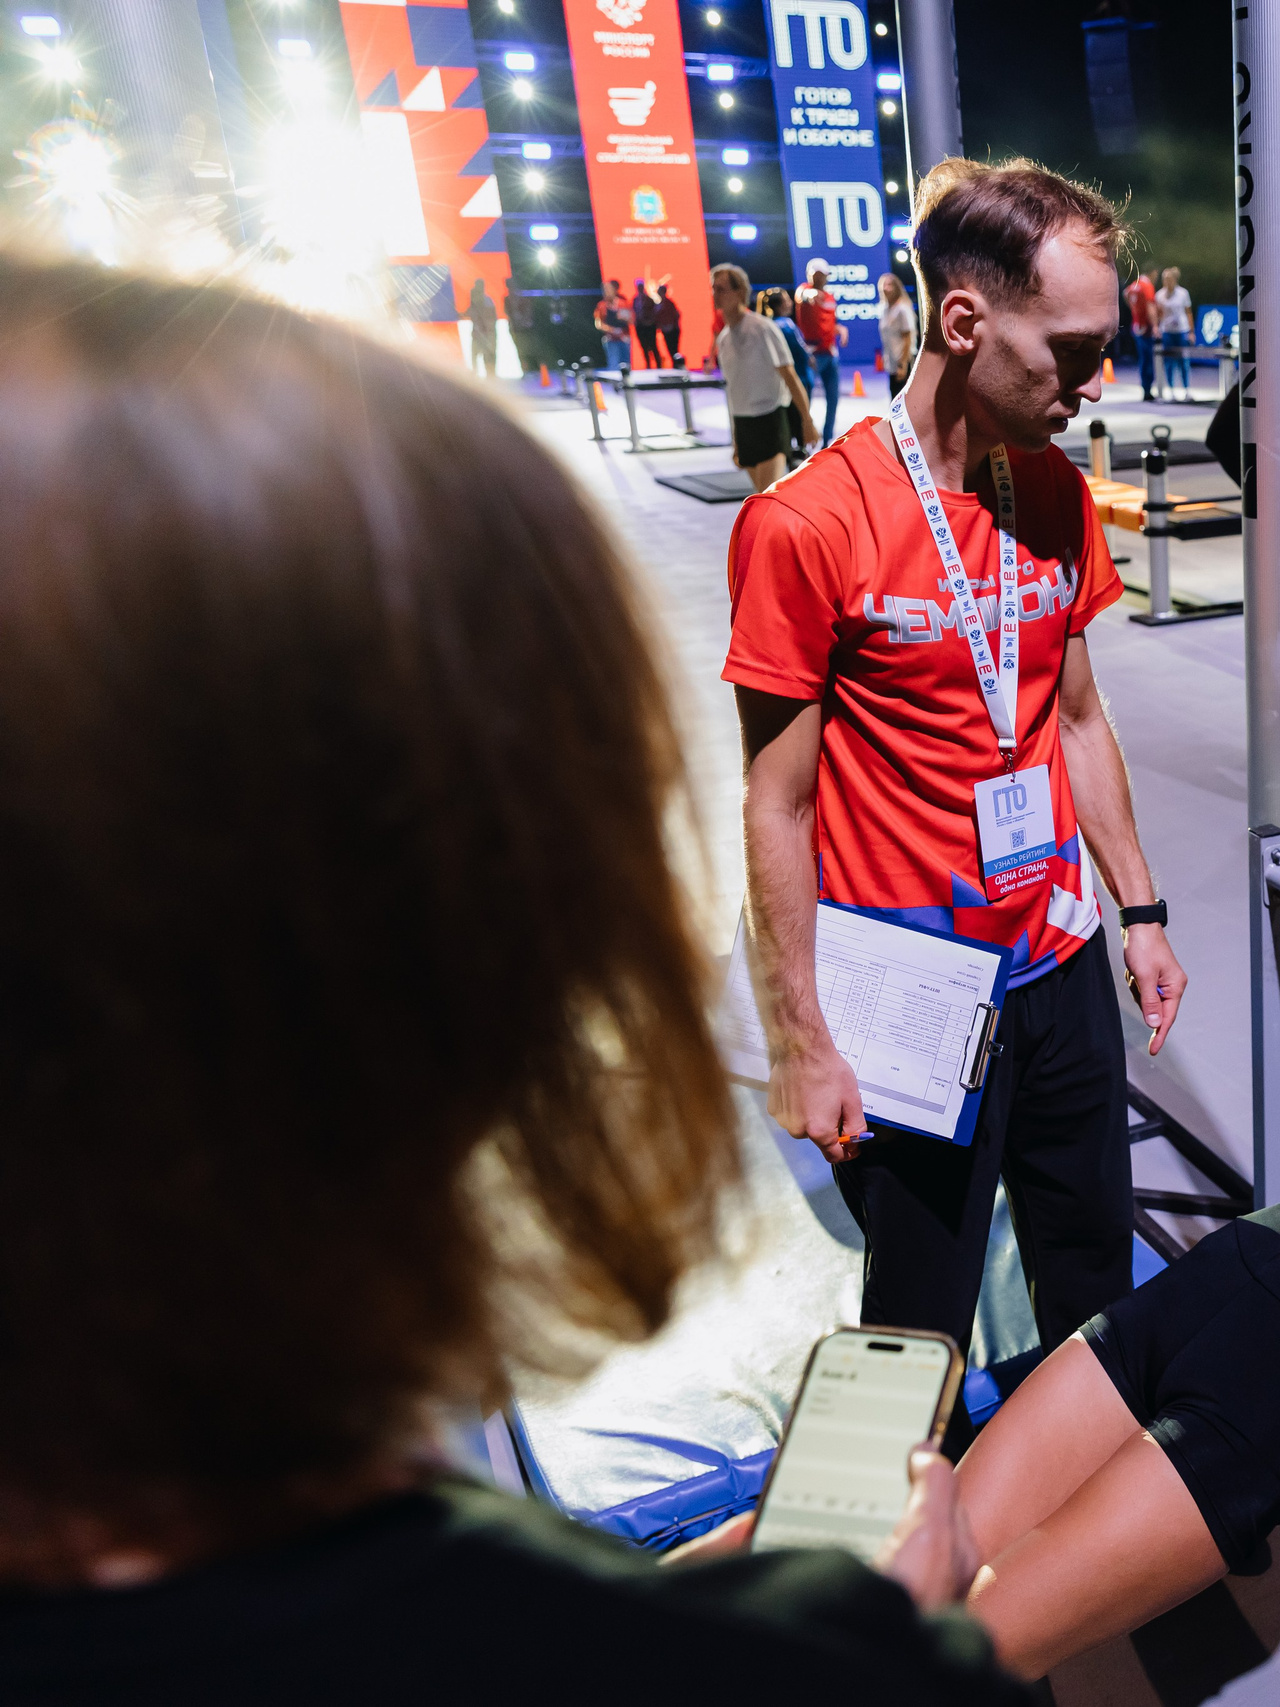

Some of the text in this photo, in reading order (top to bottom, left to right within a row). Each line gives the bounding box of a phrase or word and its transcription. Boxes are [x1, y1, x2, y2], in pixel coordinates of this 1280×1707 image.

[770, 0, 868, 71] ГТО
[794, 86, 852, 106] ГОТОВ
[790, 107, 860, 127] К ТРУДУ
[783, 128, 875, 148] И ОБОРОНЕ
[790, 181, 884, 248] ГТО
[827, 264, 869, 282] ОТОВ
[937, 574, 996, 592] ИРЫ
[993, 783, 1028, 818] ГТО
[993, 846, 1047, 870] УЗНАТЬ РЕЙТИНГ
[995, 860, 1049, 885] ОДНА СТРАНА,
[1000, 871, 1046, 894] одна команда!
